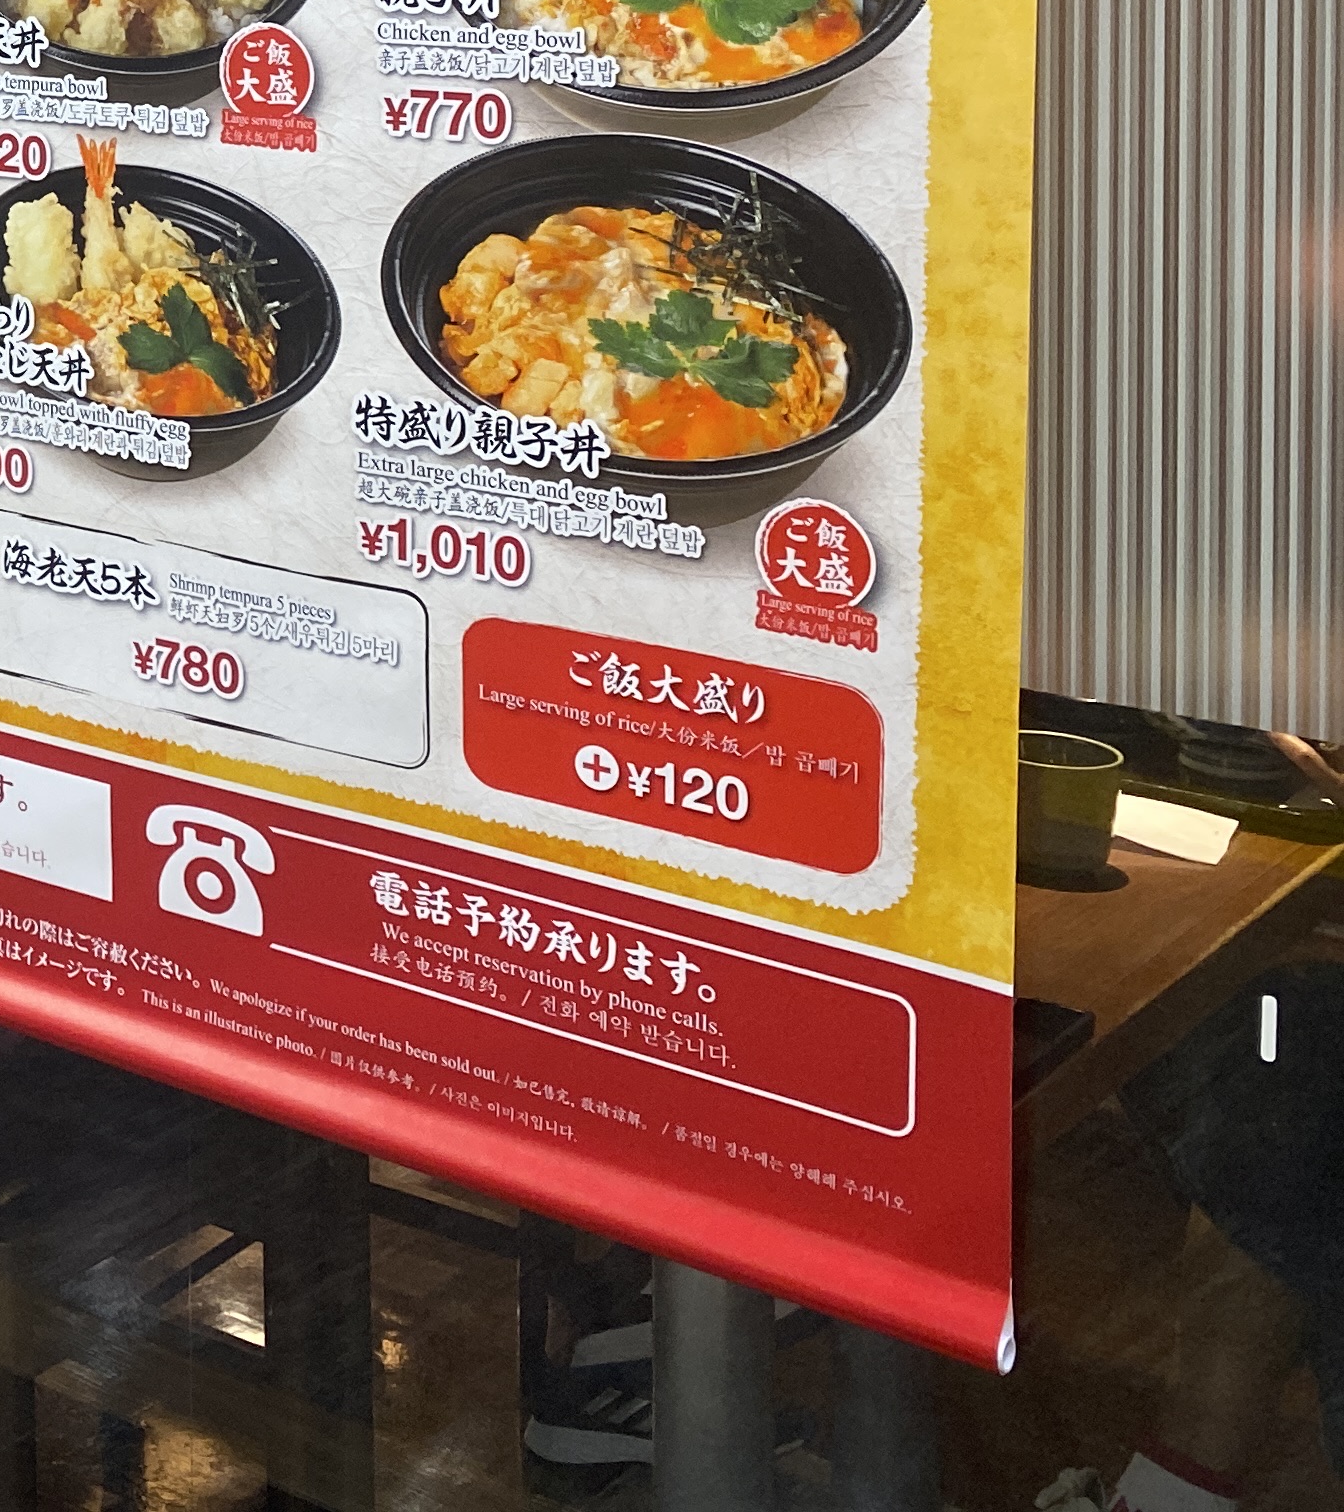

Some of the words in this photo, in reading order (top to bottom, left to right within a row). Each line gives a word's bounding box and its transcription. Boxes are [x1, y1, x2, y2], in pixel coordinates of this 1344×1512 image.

[377, 23, 451, 43] Chicken
[456, 27, 490, 45] and
[495, 32, 528, 51] egg
[534, 30, 582, 50] bowl
[384, 90, 507, 138] ¥770
[356, 395, 605, 473] 特盛り親子丼
[3, 540, 159, 606] 海老天5本
[359, 518, 526, 582] ¥1,010
[133, 638, 239, 695] ¥780
[567, 649, 766, 725] ご飯大盛り
[627, 762, 748, 822] ¥120
[369, 870, 717, 1004] 電話予約承ります。
